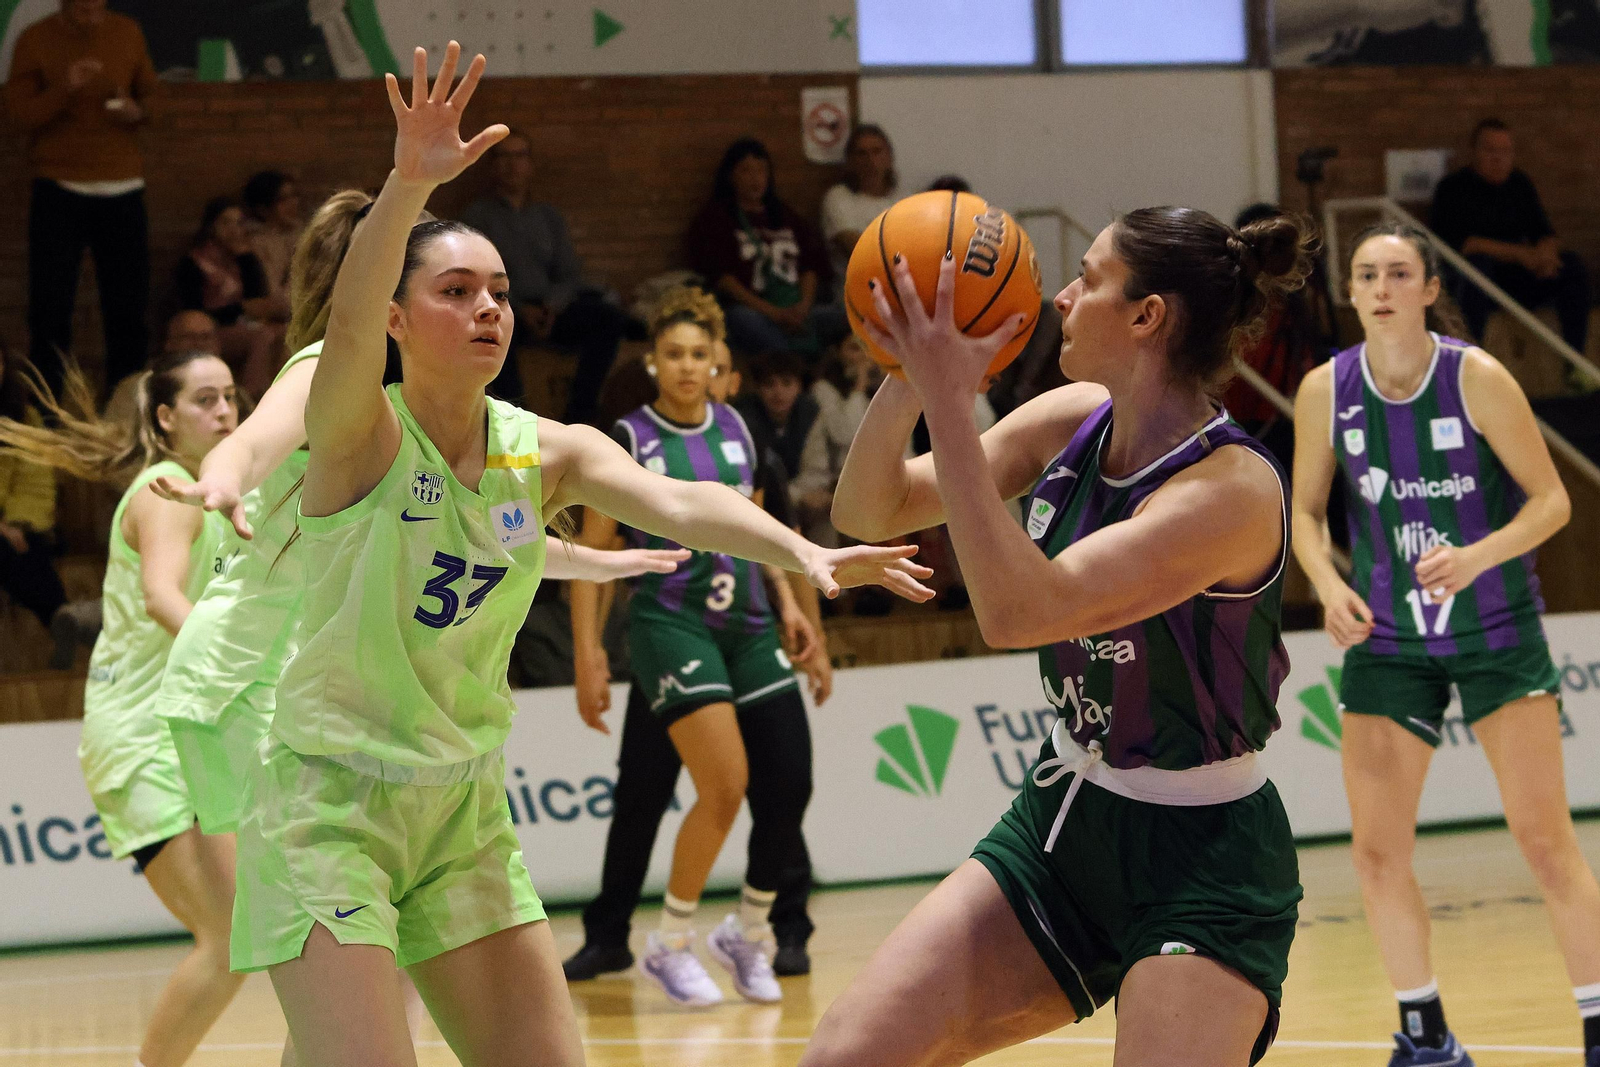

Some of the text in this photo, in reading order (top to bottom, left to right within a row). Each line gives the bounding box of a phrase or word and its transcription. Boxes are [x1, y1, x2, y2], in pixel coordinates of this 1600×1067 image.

[1390, 472, 1477, 501] Unicaja
[1393, 521, 1454, 562] Mijas
[413, 550, 509, 629] 33
[706, 573, 735, 612] 3
[1405, 588, 1456, 635] 17
[974, 703, 1058, 745] Fun
[1043, 675, 1113, 735] Mijas
[504, 766, 618, 826] ica
[0, 803, 114, 866] ica
